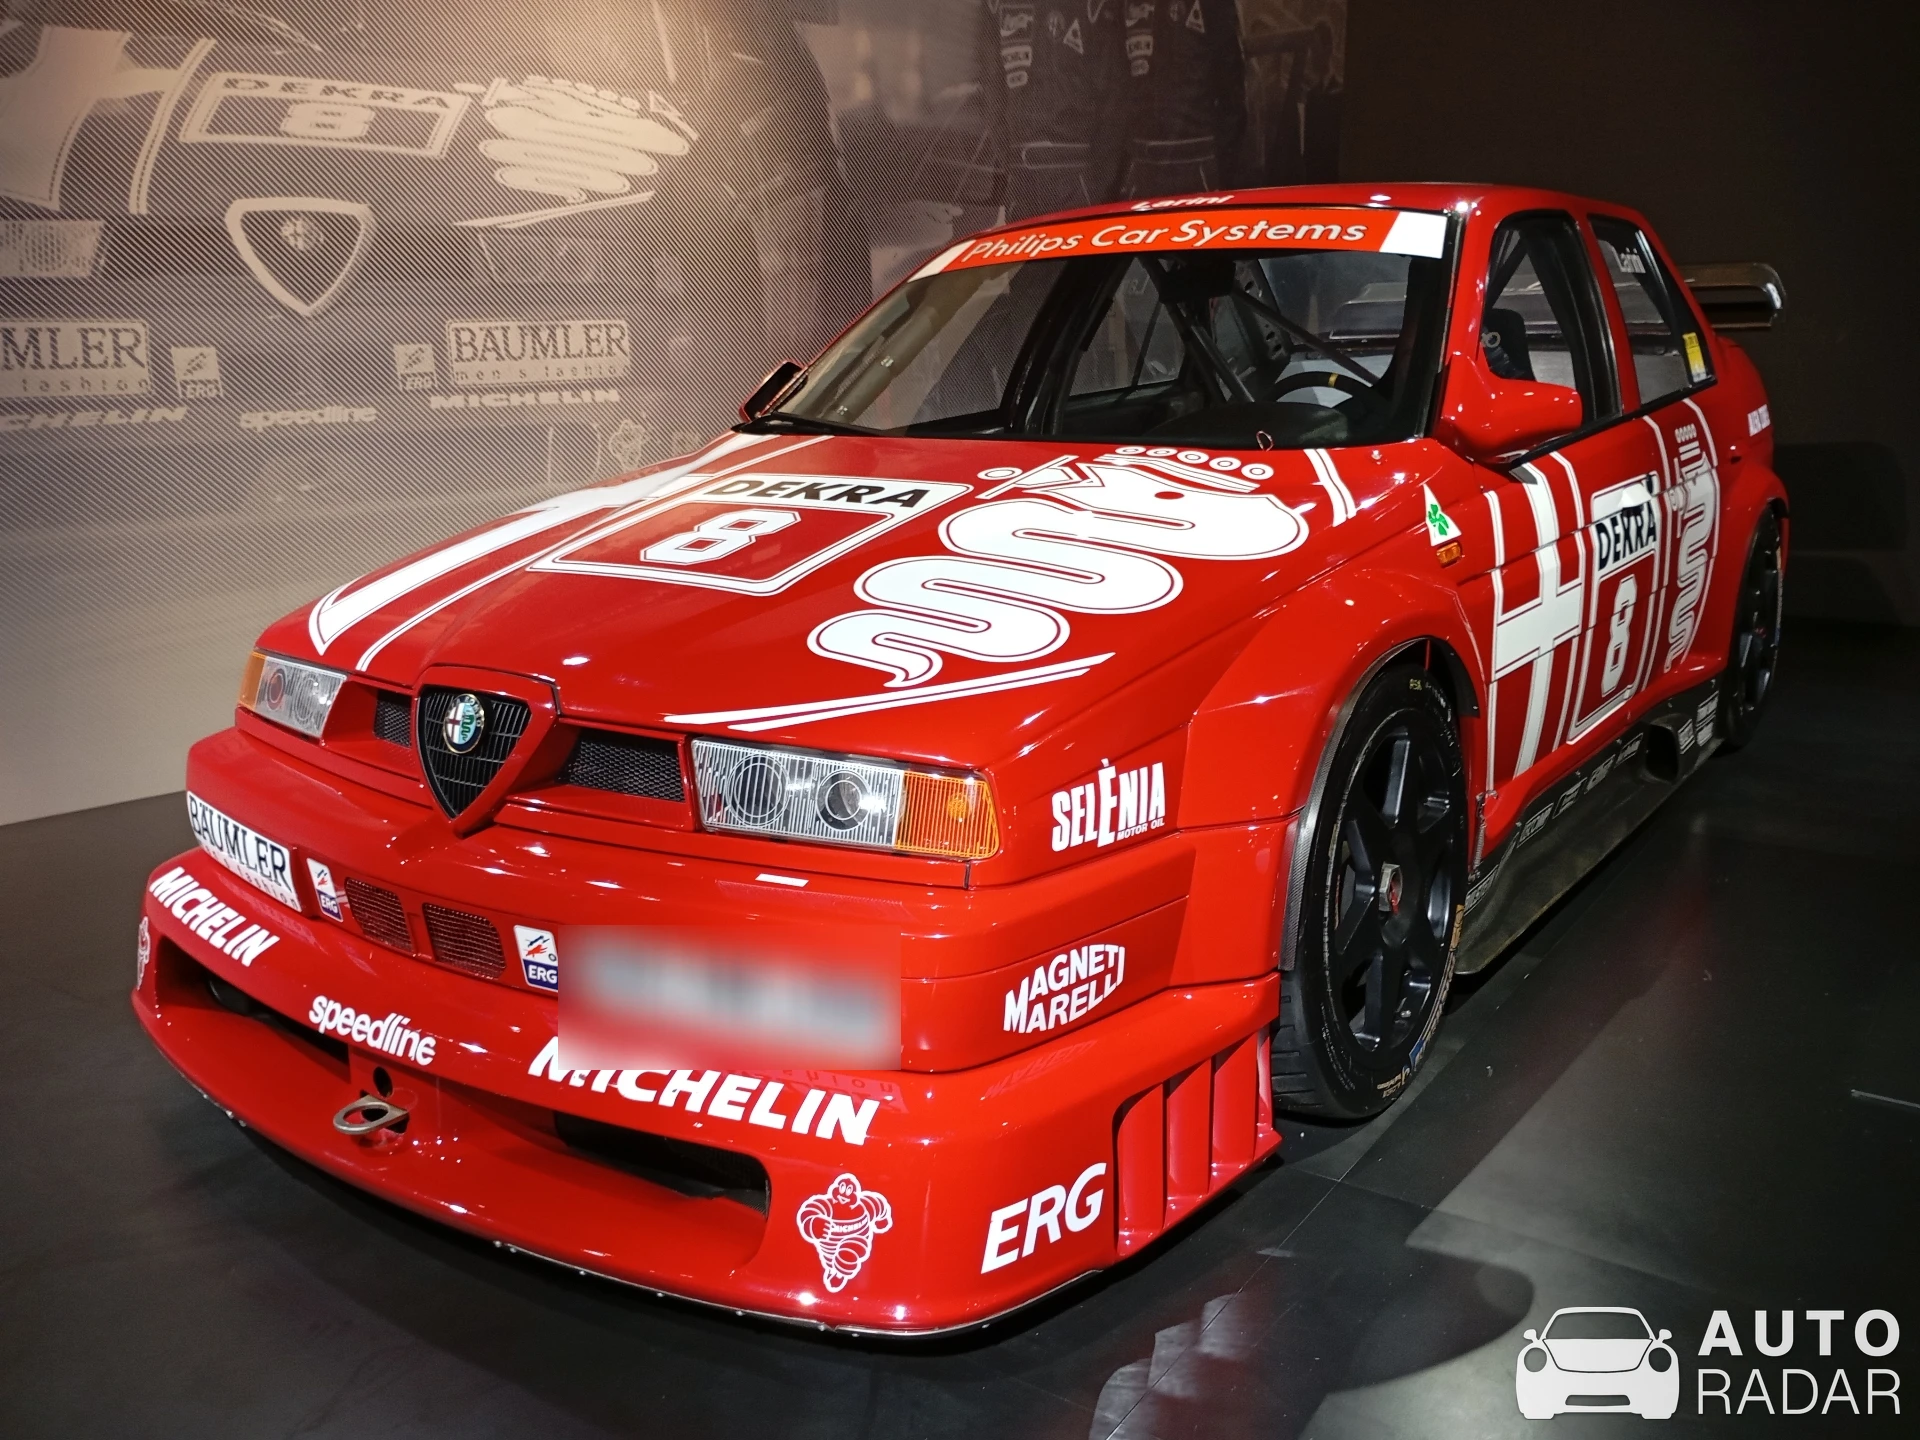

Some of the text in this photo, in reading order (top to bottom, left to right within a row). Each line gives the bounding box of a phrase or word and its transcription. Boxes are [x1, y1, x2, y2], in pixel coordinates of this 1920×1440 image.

[222, 77, 450, 109] DEKRA
[961, 218, 1368, 262] Philips Car Systems
[430, 388, 621, 409] MICHELIN
[702, 479, 931, 508] DEKRA
[639, 508, 801, 565] 8
[1601, 573, 1638, 698] 8
[188, 794, 293, 894] BÄUMLER
[1116, 817, 1165, 841] MOTOR OIL
[148, 865, 281, 968] MICHELIN
[320, 893, 339, 914] ERG
[528, 964, 558, 984] ERG
[1003, 944, 1126, 1022] MAGNETI
[1003, 965, 1126, 1034] MARELLI
[308, 994, 437, 1066] speedline
[980, 1162, 1108, 1275] ERG
